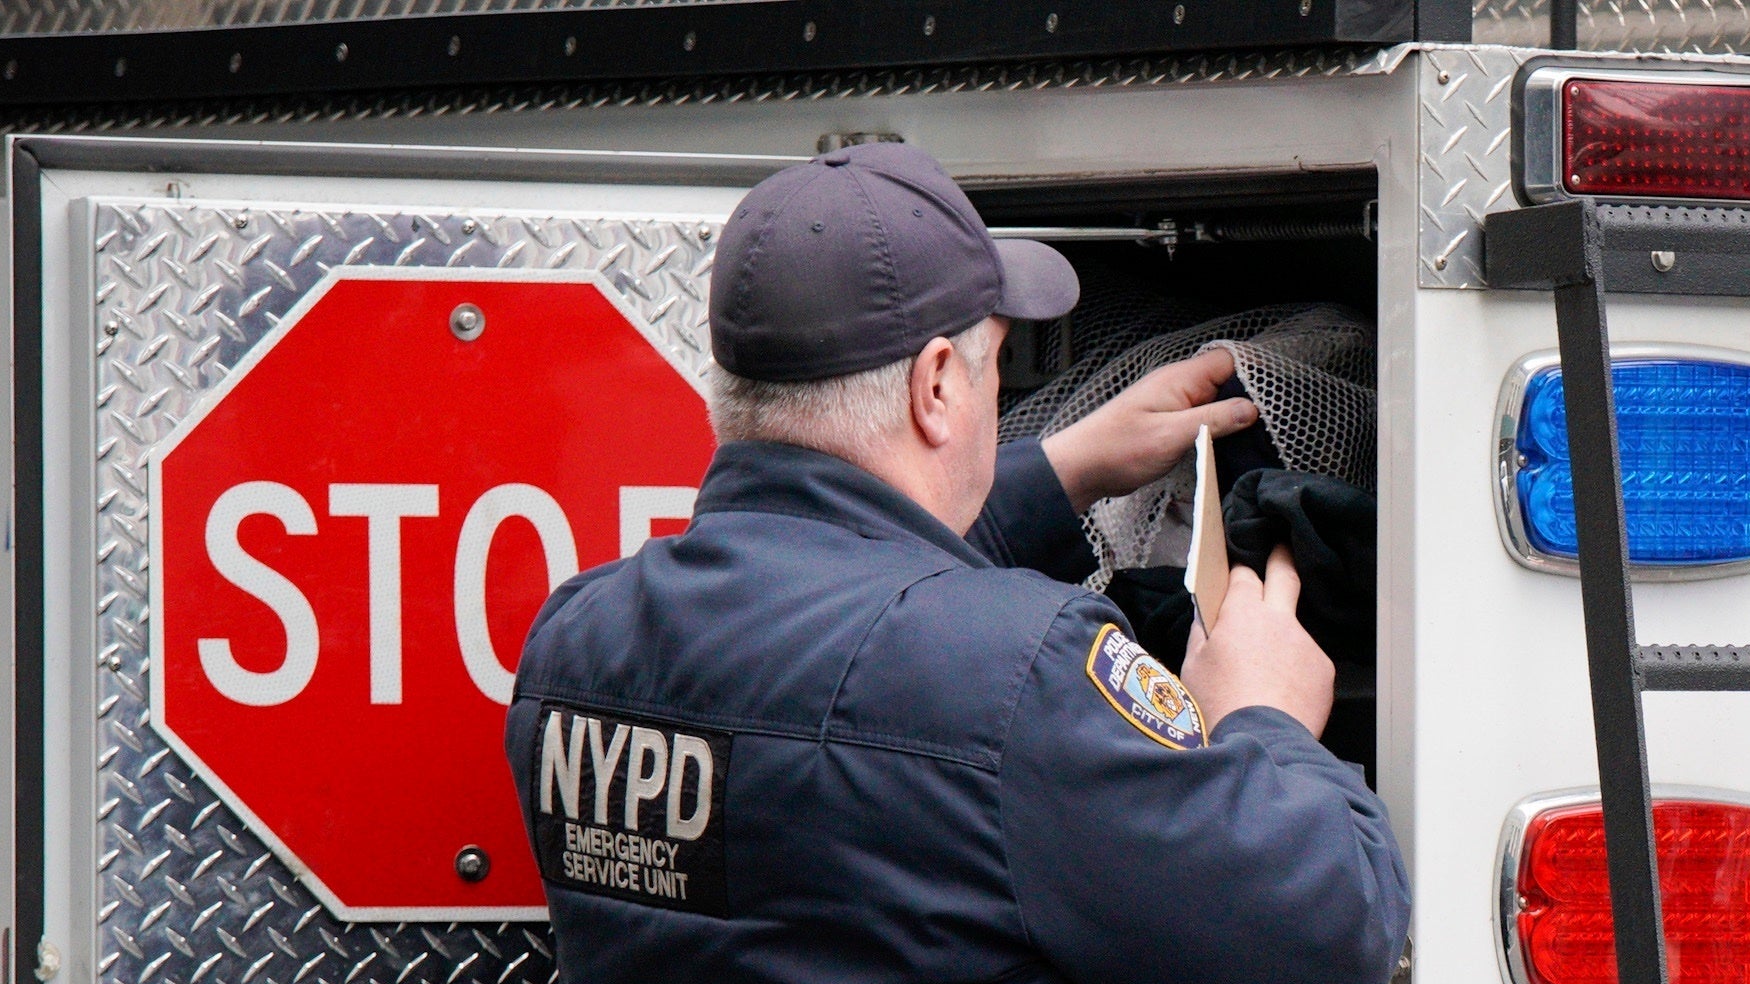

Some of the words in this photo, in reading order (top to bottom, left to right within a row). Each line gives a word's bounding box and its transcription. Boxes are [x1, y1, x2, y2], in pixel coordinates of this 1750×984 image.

[198, 480, 702, 707] STO
[1131, 702, 1165, 730] CITY
[1167, 723, 1185, 741] OF
[540, 710, 714, 842] NYPD
[565, 822, 679, 869] EMERGENCY
[562, 850, 640, 891] SERVICE
[644, 867, 688, 900] UNIT
